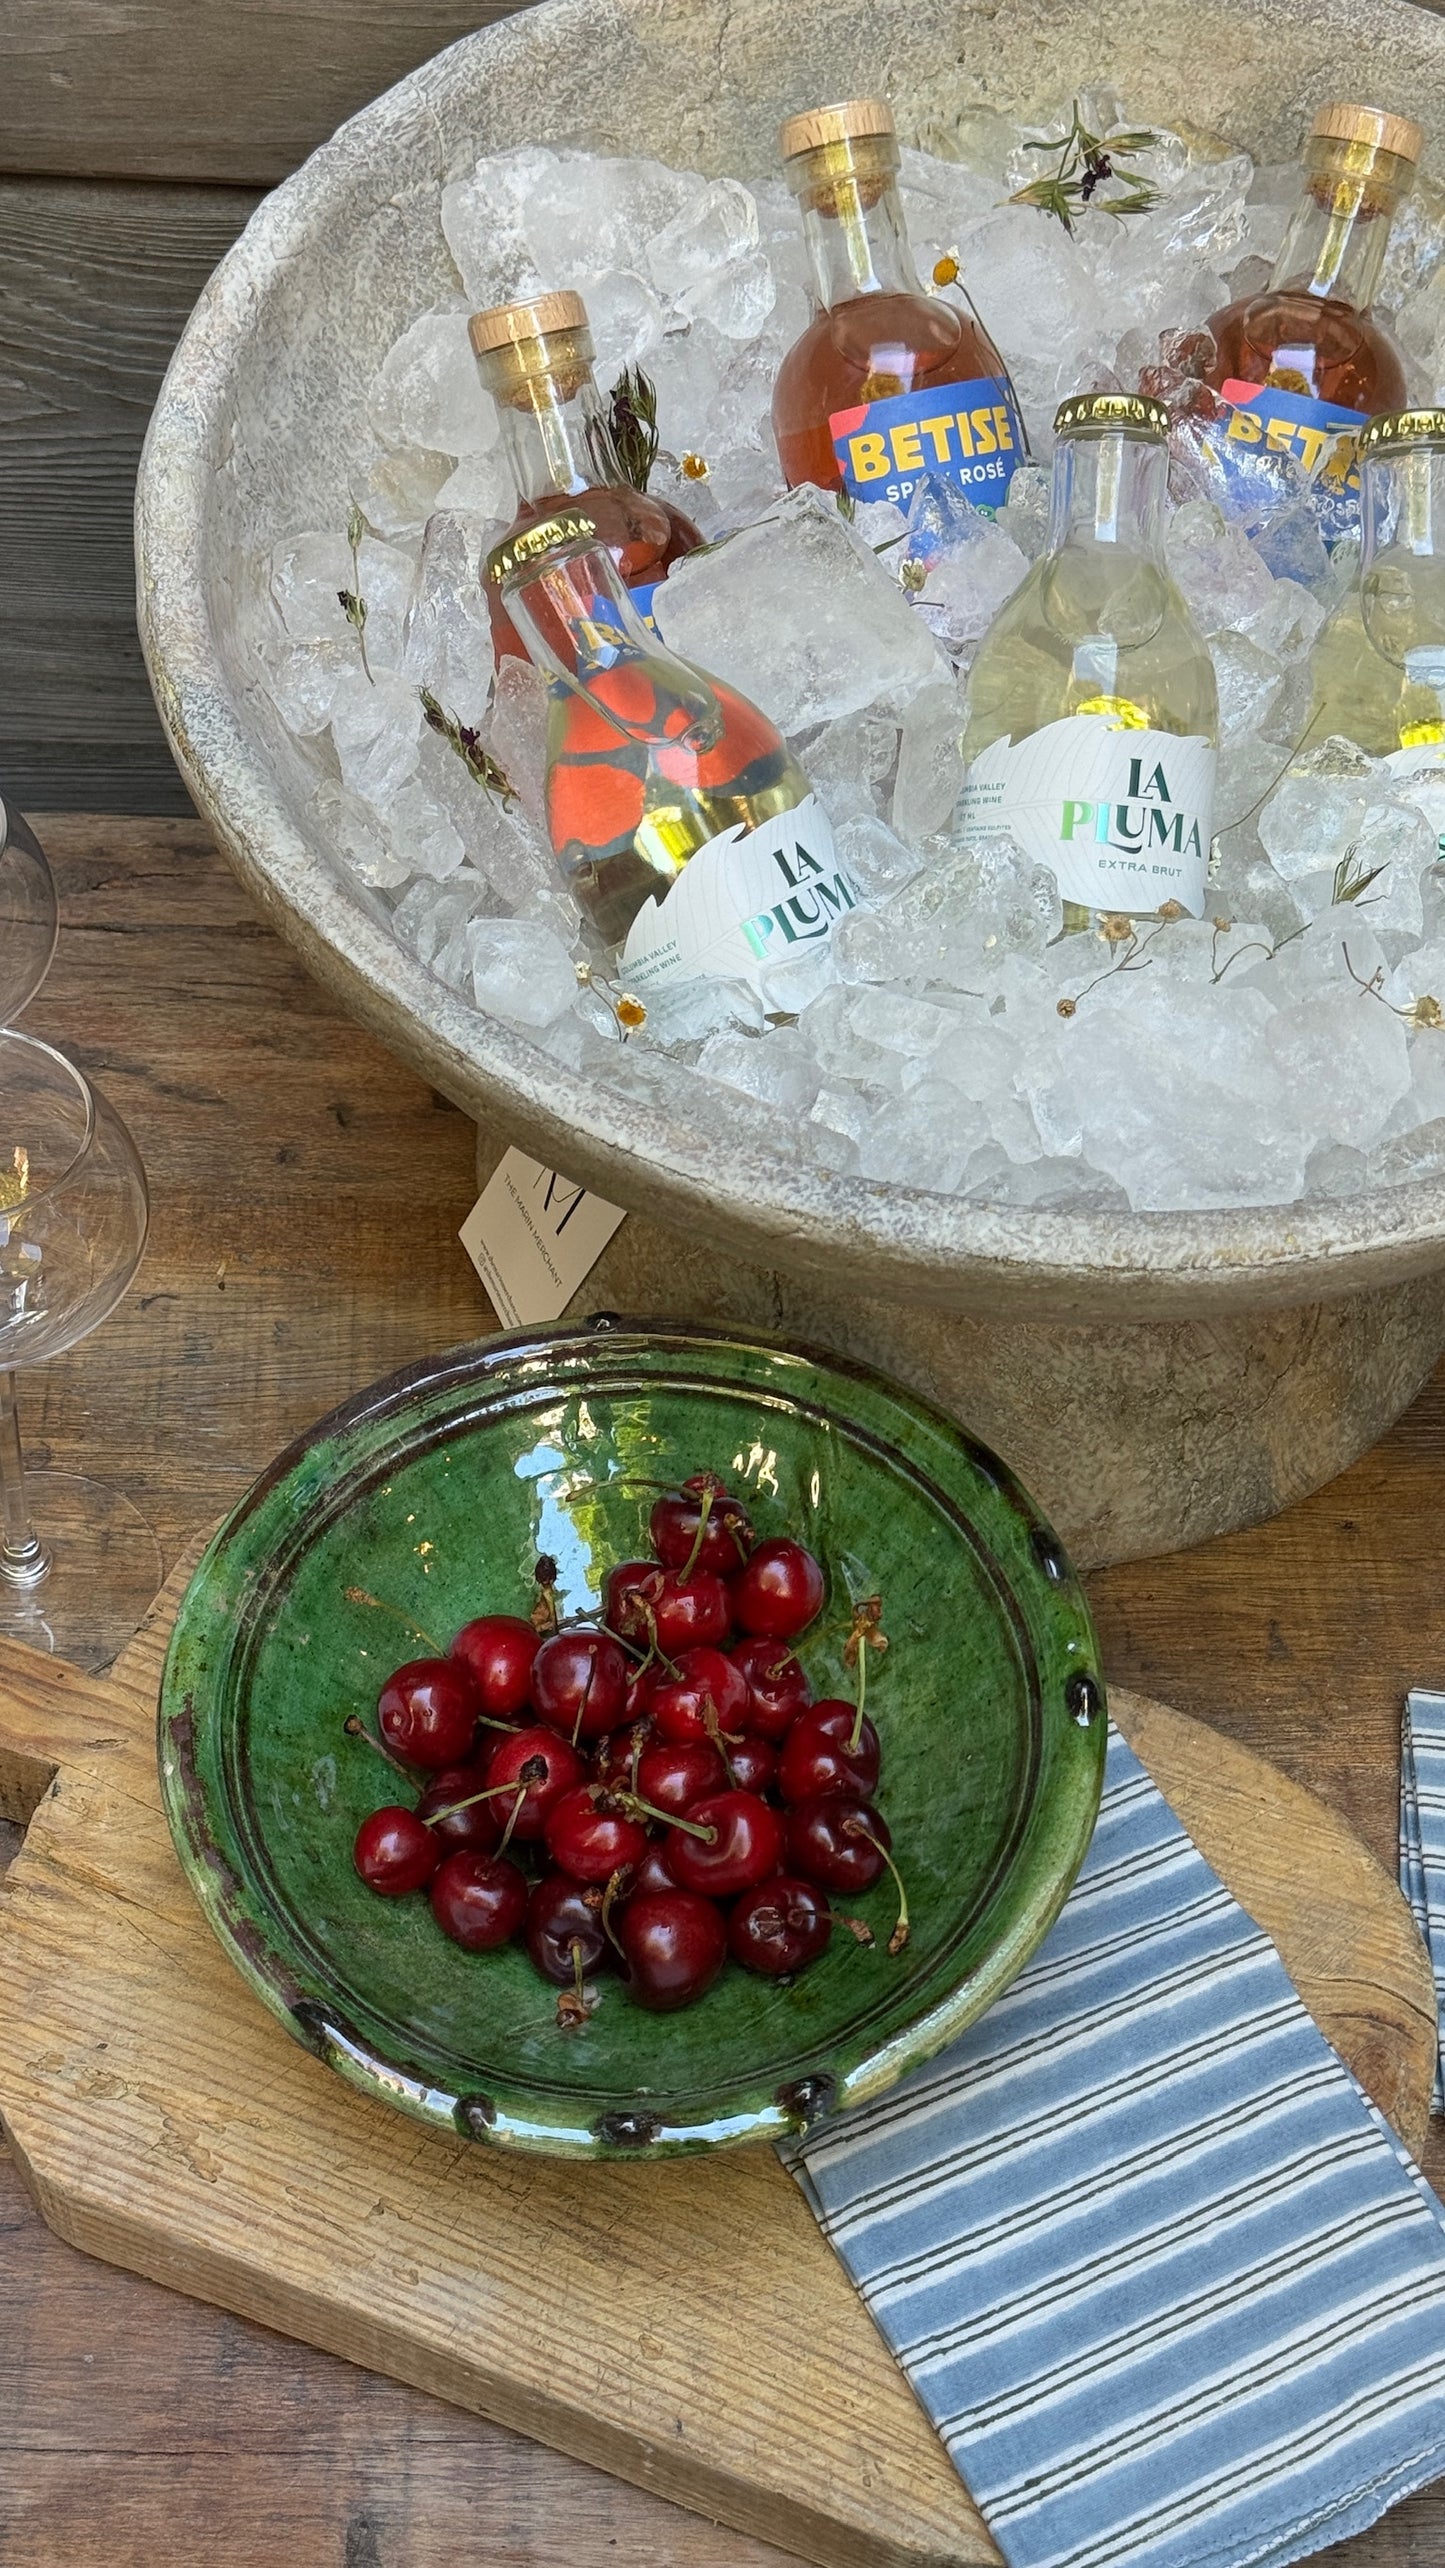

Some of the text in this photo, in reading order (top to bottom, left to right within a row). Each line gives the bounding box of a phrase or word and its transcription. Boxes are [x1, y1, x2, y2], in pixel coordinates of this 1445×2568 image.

[848, 406, 1014, 483] BETISE
[959, 457, 1005, 485] ROSÉ
[979, 783, 1006, 791] VALLEY
[1127, 758, 1172, 803] LA
[982, 796, 1002, 804] WINE
[1059, 800, 1203, 858] PLUMA
[772, 841, 825, 889] LA
[1098, 859, 1183, 878] EXTRA BRUT
[740, 873, 857, 961] PLUM
[648, 940, 678, 960] VALLEY
[659, 954, 682, 970] WINE
[503, 1172, 563, 1289] THE MARIN MERCHANT
